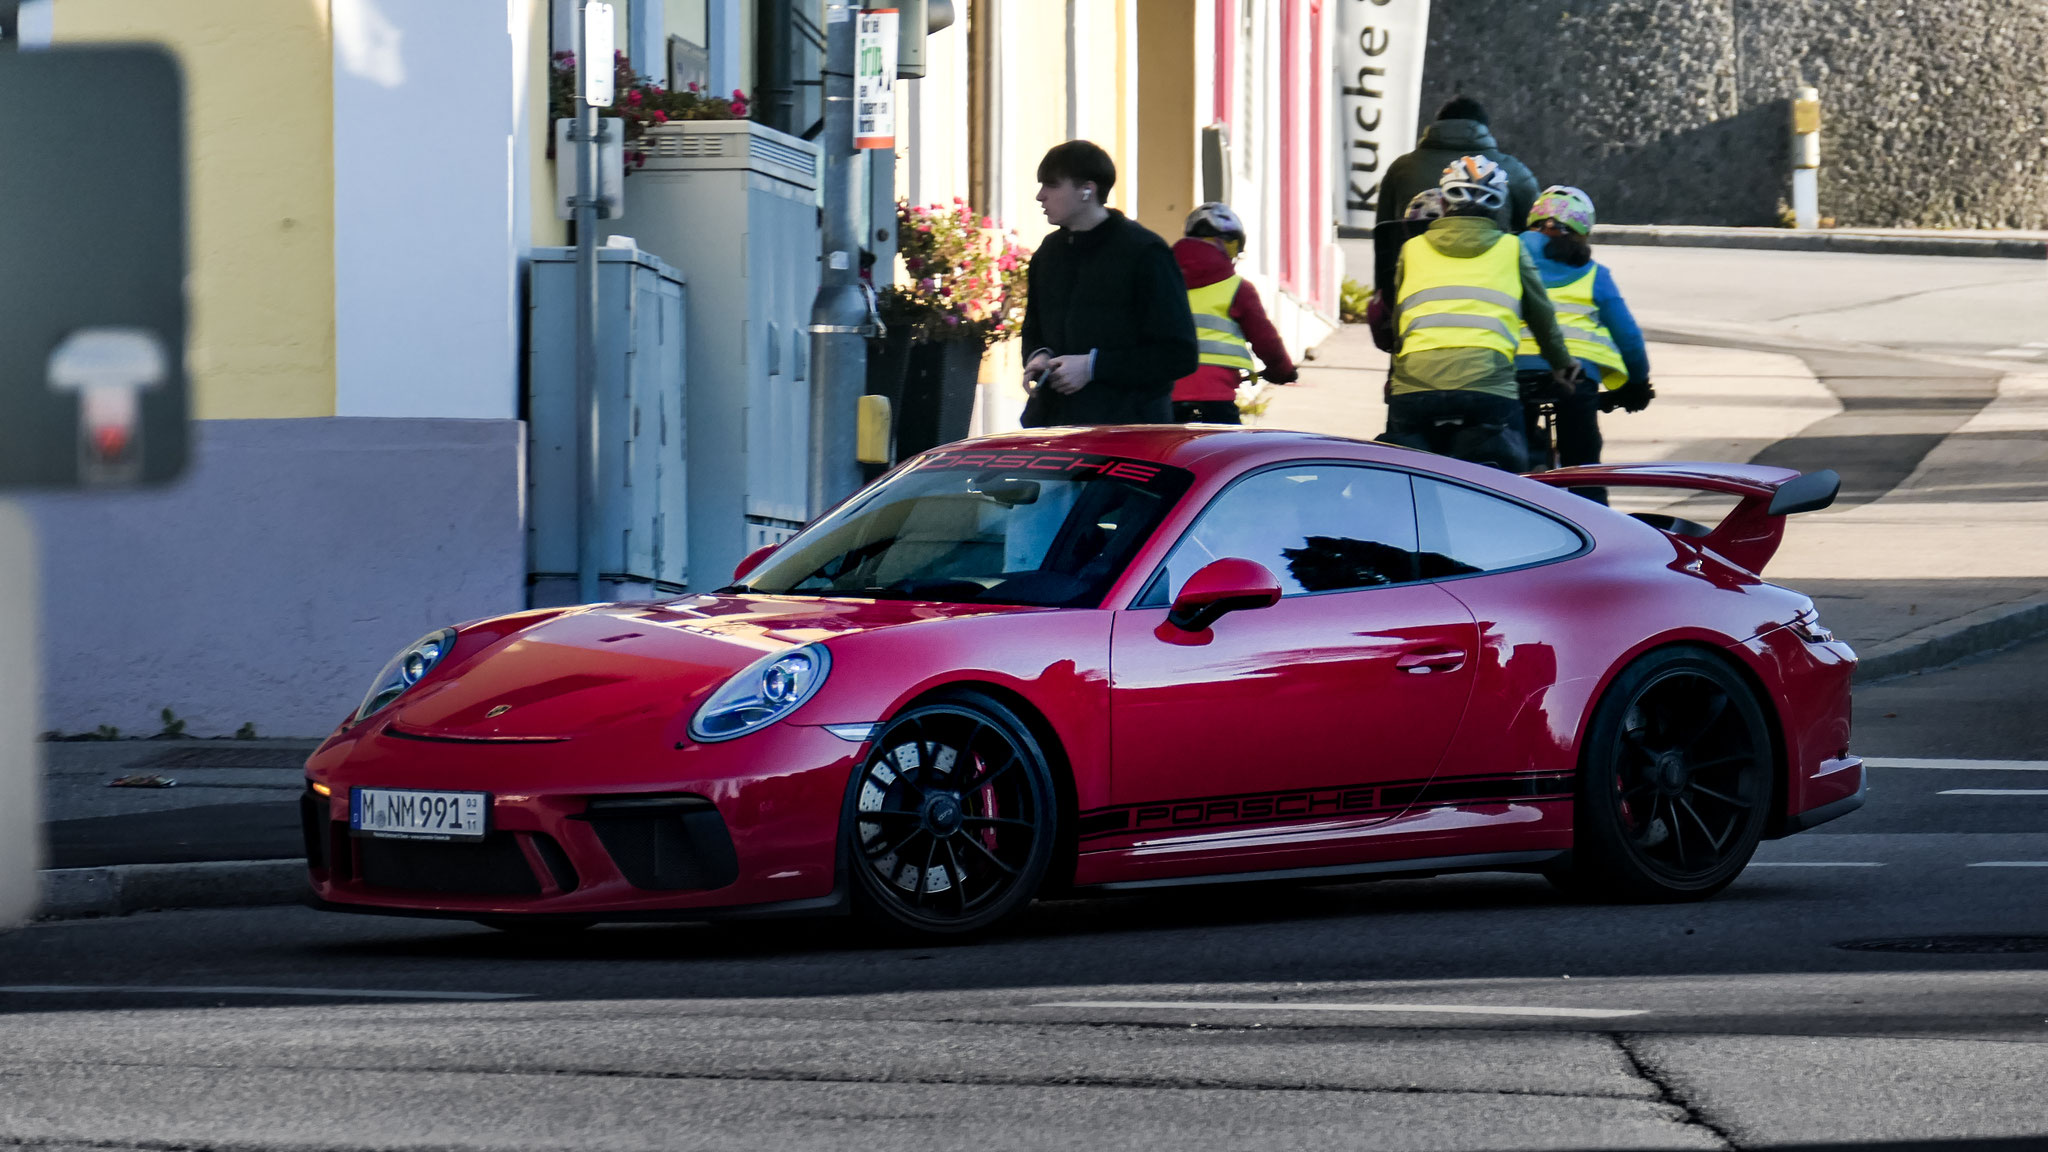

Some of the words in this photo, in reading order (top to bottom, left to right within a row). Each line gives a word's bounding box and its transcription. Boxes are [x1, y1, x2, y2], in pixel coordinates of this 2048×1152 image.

[362, 792, 374, 825] M
[466, 798, 477, 808] 03
[1136, 789, 1374, 828] PORSCHE
